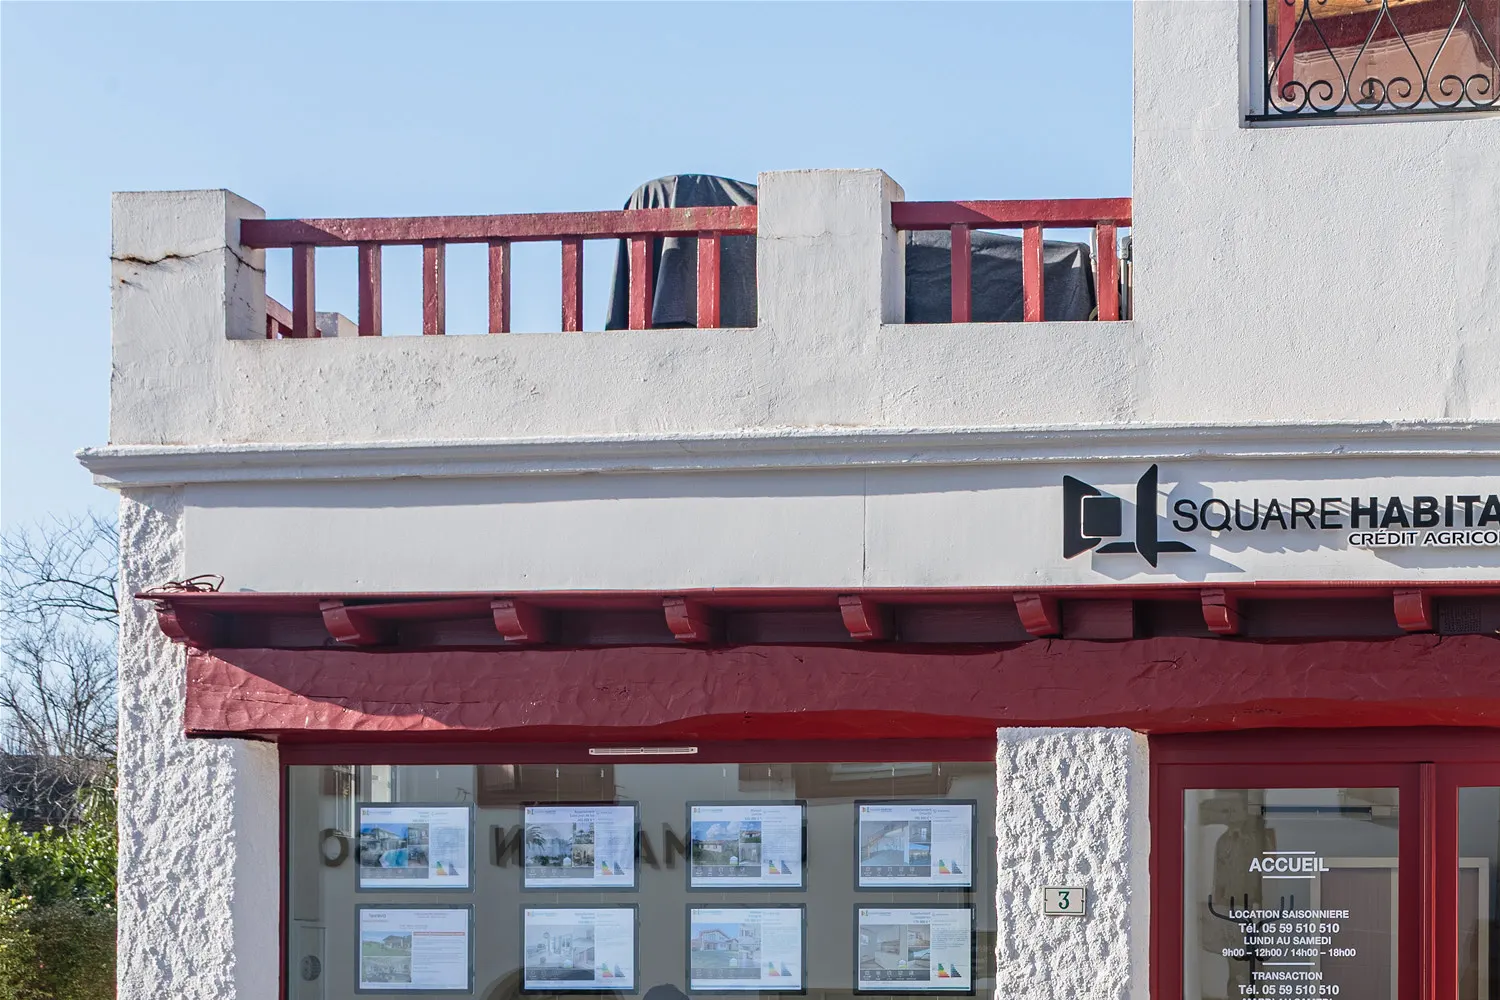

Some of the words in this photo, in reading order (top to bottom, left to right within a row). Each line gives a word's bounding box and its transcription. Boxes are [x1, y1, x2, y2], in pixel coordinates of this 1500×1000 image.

[1172, 497, 1342, 533] SQUARE
[1349, 529, 1418, 546] CRÉDIT
[1249, 858, 1329, 872] ACCUEIL
[1058, 891, 1070, 909] 3
[1229, 910, 1280, 919] LOCATION
[1282, 910, 1349, 919] SAISONNIERE
[1239, 923, 1259, 933] Tél.
[1263, 923, 1276, 933] 05
[1279, 923, 1293, 933] 59
[1296, 923, 1316, 933] 510
[1319, 923, 1339, 933] 510
[1244, 937, 1274, 945] LUNDI
[1276, 937, 1290, 945] AU
[1293, 937, 1332, 945] SAMEDI
[1222, 948, 1244, 957] 9h00
[1254, 948, 1282, 957] 12h00
[1291, 948, 1318, 957] 14h00
[1328, 948, 1356, 957] 18h00
[1252, 972, 1323, 980] TRANSACTION
[1239, 985, 1259, 995] Tél.
[1262, 985, 1276, 995] 05
[1279, 985, 1293, 995] 59
[1296, 985, 1316, 995] 510
[1319, 985, 1339, 995] 510
